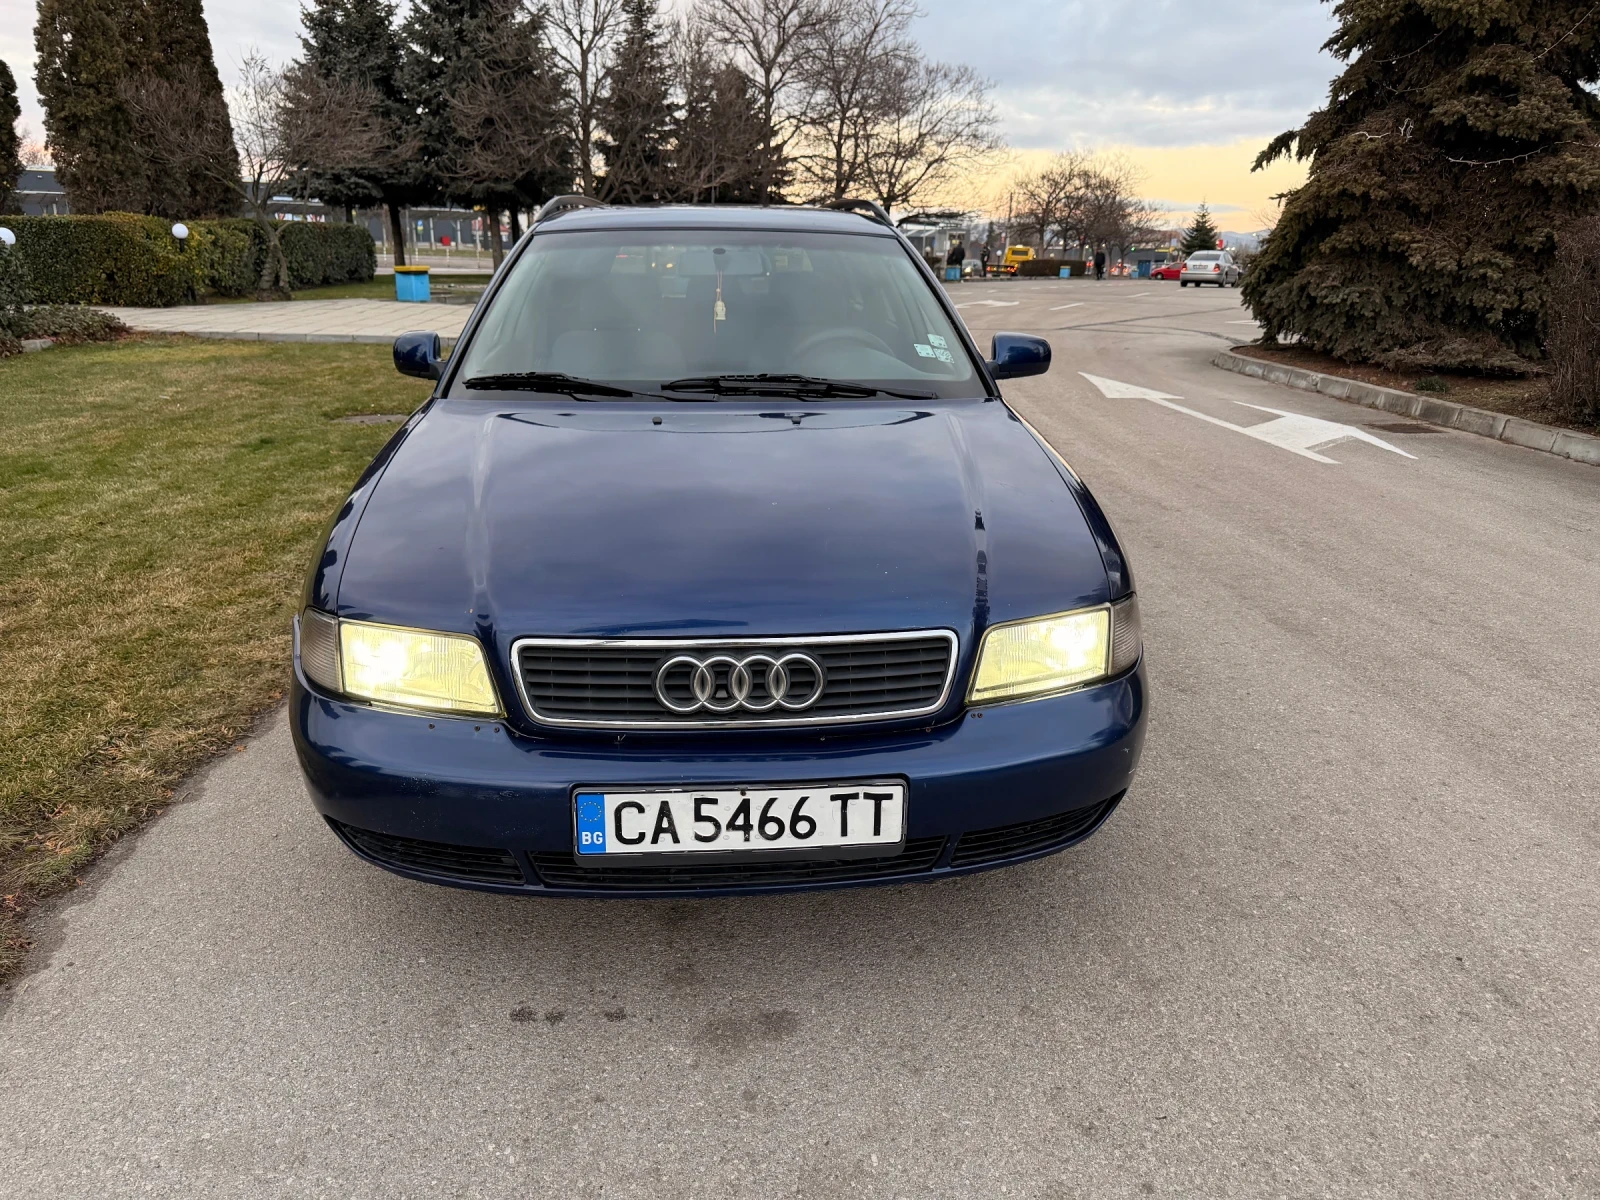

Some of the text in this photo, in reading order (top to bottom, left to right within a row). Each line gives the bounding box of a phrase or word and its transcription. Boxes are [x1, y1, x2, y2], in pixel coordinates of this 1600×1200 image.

[614, 792, 893, 845] CA 5466 TT
[581, 832, 603, 845] BG
